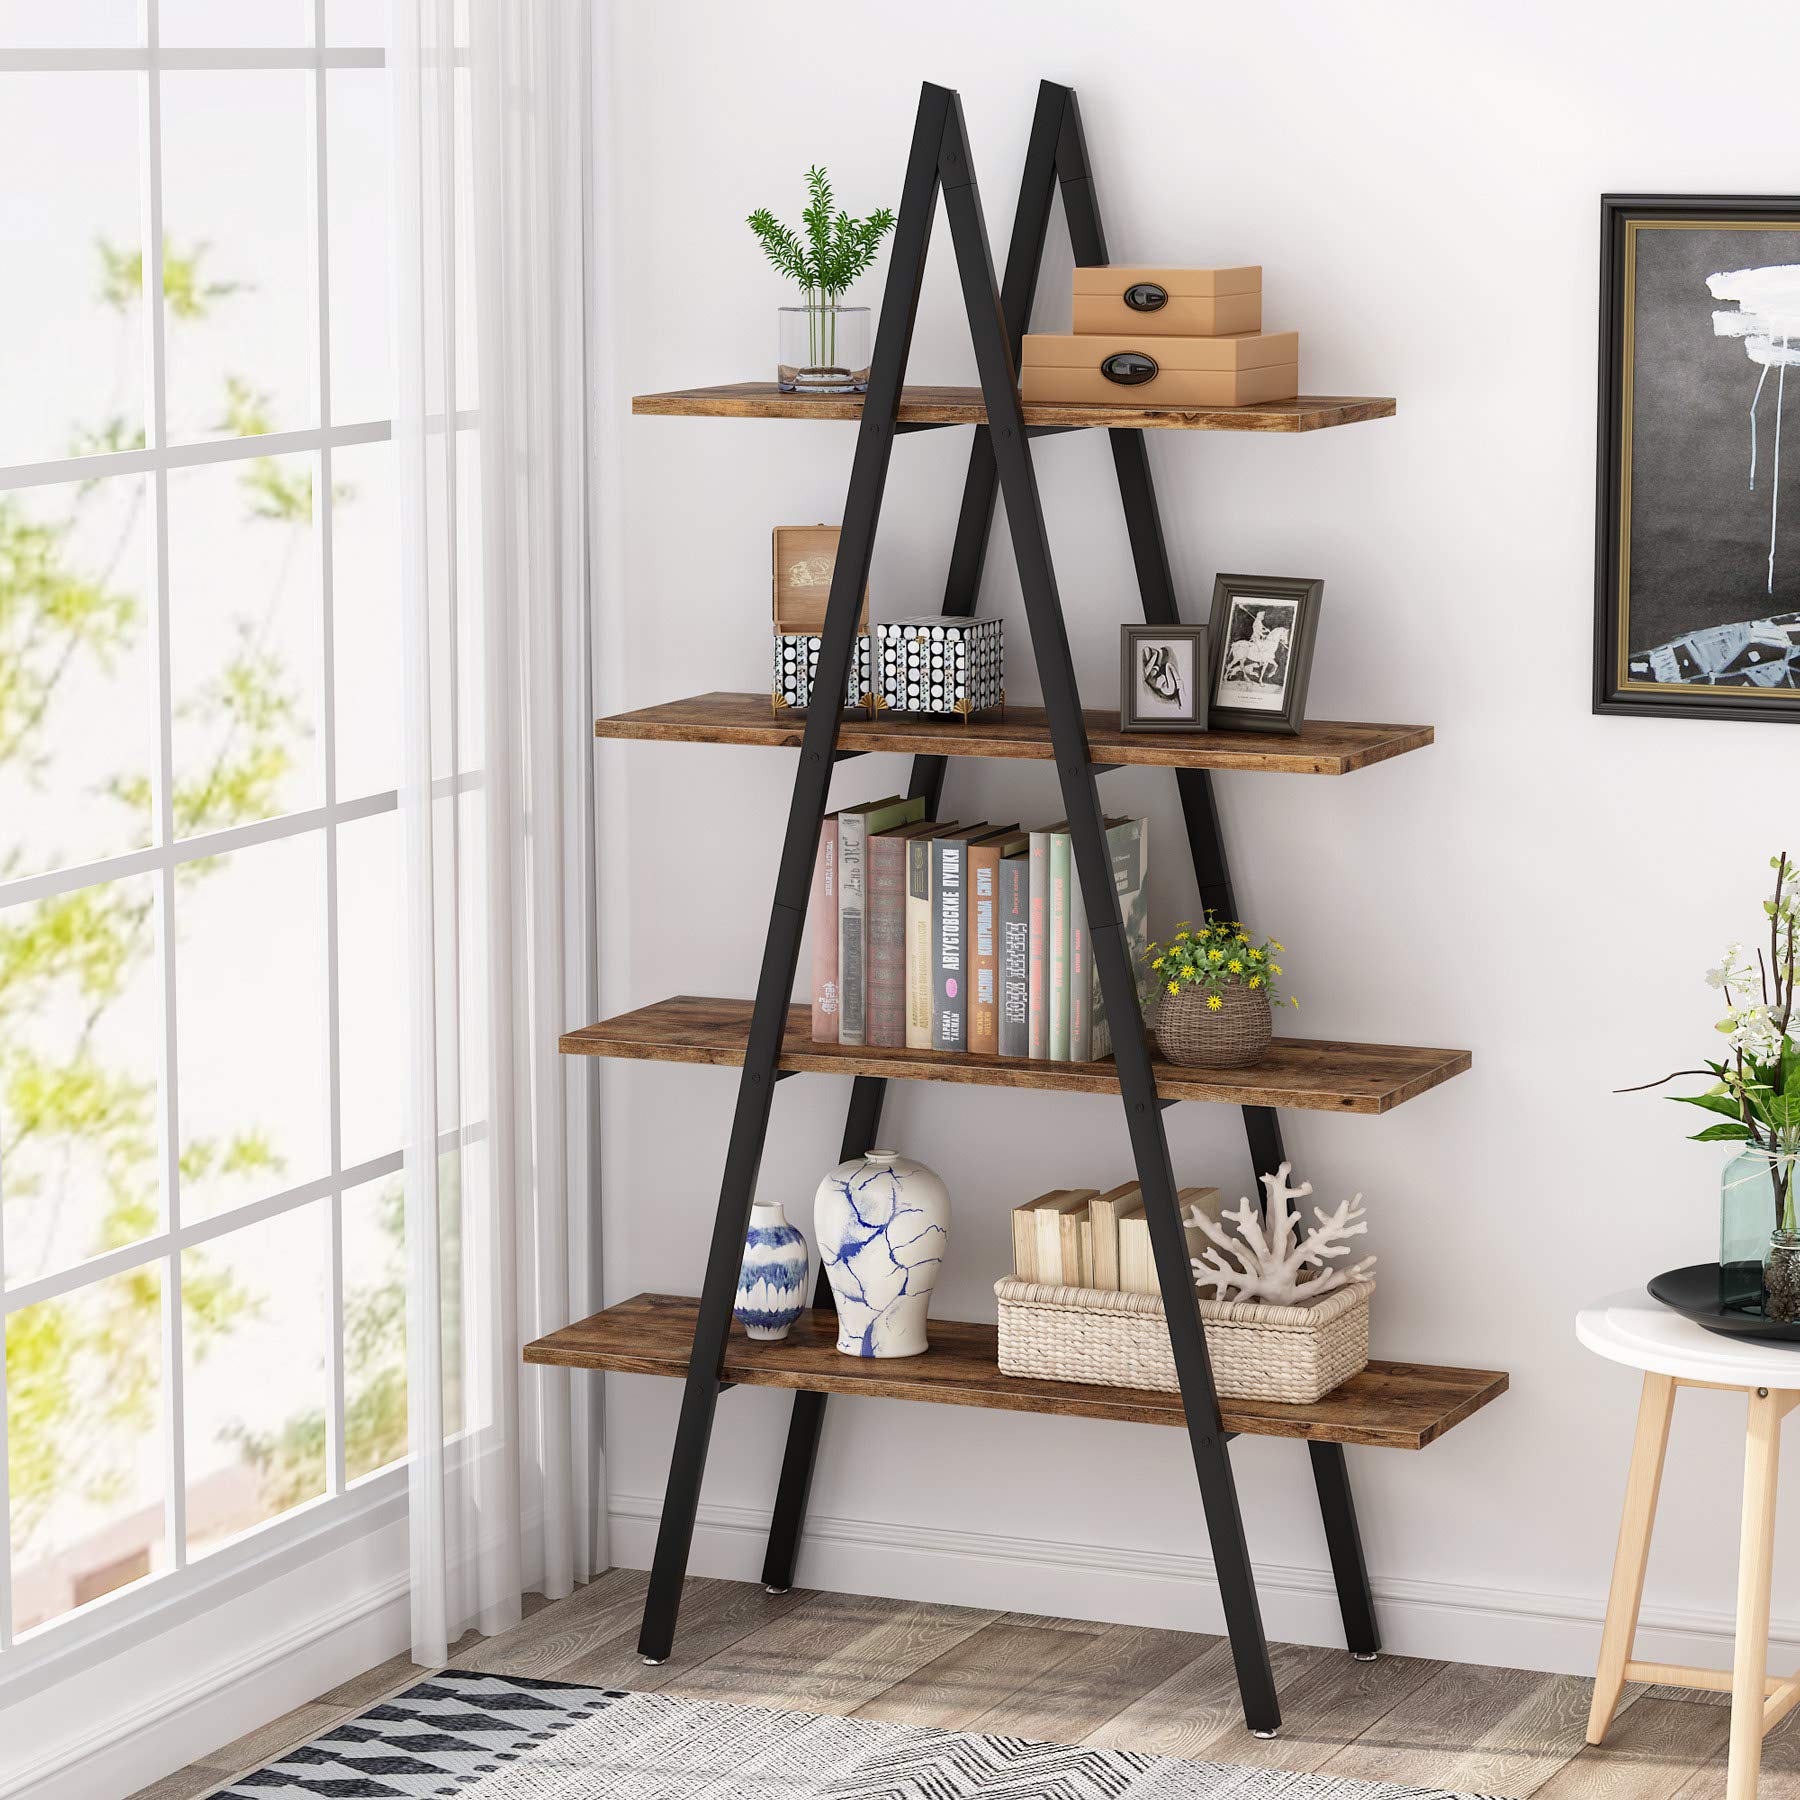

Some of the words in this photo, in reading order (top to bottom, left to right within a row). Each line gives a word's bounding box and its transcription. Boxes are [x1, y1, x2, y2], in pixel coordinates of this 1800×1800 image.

[942, 849, 959, 887] ПУШКИ
[942, 892, 959, 970] АВГУСТОВСКИЕ
[1006, 922, 1027, 978] ЛЕГЕНД
[942, 1010, 951, 1041] БАРБАРА
[950, 1013, 960, 1042] ТАКМАН
